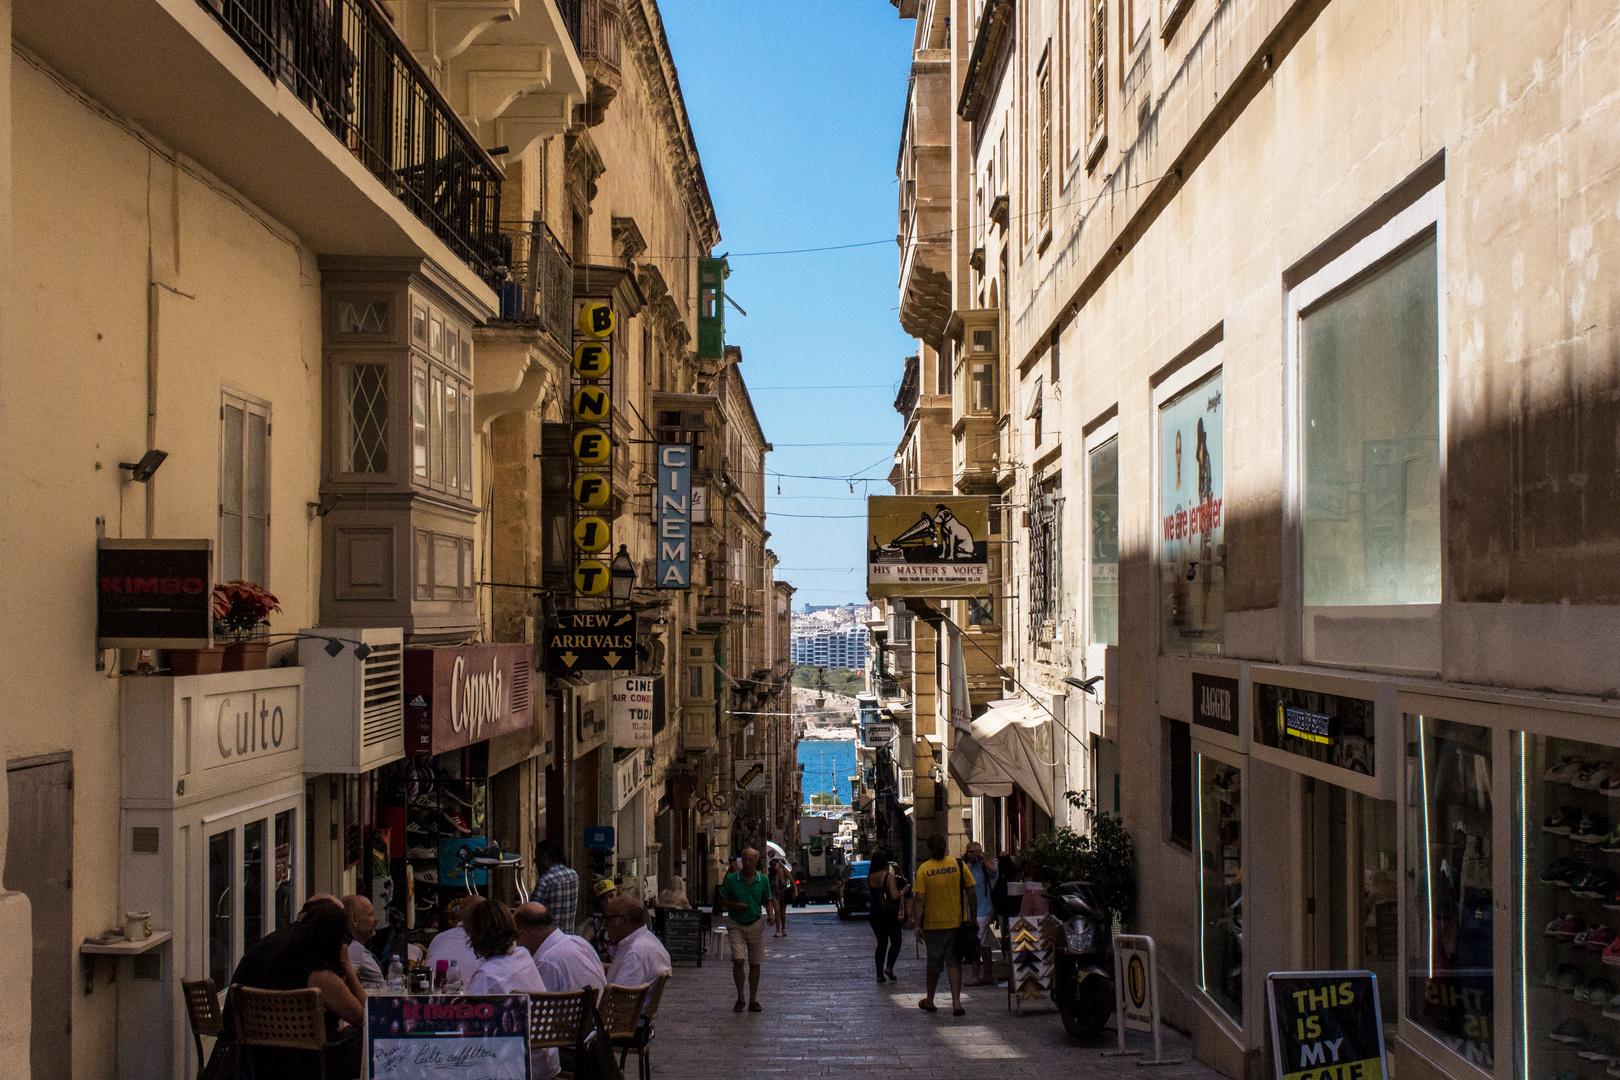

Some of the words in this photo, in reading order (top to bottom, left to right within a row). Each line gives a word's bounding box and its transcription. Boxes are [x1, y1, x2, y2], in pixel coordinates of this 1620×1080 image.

[577, 305, 613, 592] BENEFIT
[661, 447, 686, 585] CINEMA
[1163, 514, 1175, 542] we
[1175, 509, 1188, 540] are
[873, 565, 891, 575] HIS
[896, 565, 947, 575] MASTER'S
[953, 565, 984, 575] VOICE
[101, 576, 204, 595] KIMBO
[572, 613, 612, 628] NEW
[550, 634, 633, 649] ARRIVALS
[451, 654, 502, 742] Coppola
[612, 693, 627, 702] AIR
[1200, 685, 1232, 722] JAGGER
[217, 692, 284, 759] Culto
[175, 779, 185, 797] 49
[926, 866, 958, 877] LEADER
[1292, 981, 1355, 1013] THIS
[402, 1003, 495, 1020] KIMBO
[1296, 1015, 1322, 1040] IS
[414, 1043, 443, 1065] Culto
[1300, 1038, 1344, 1068] MY
